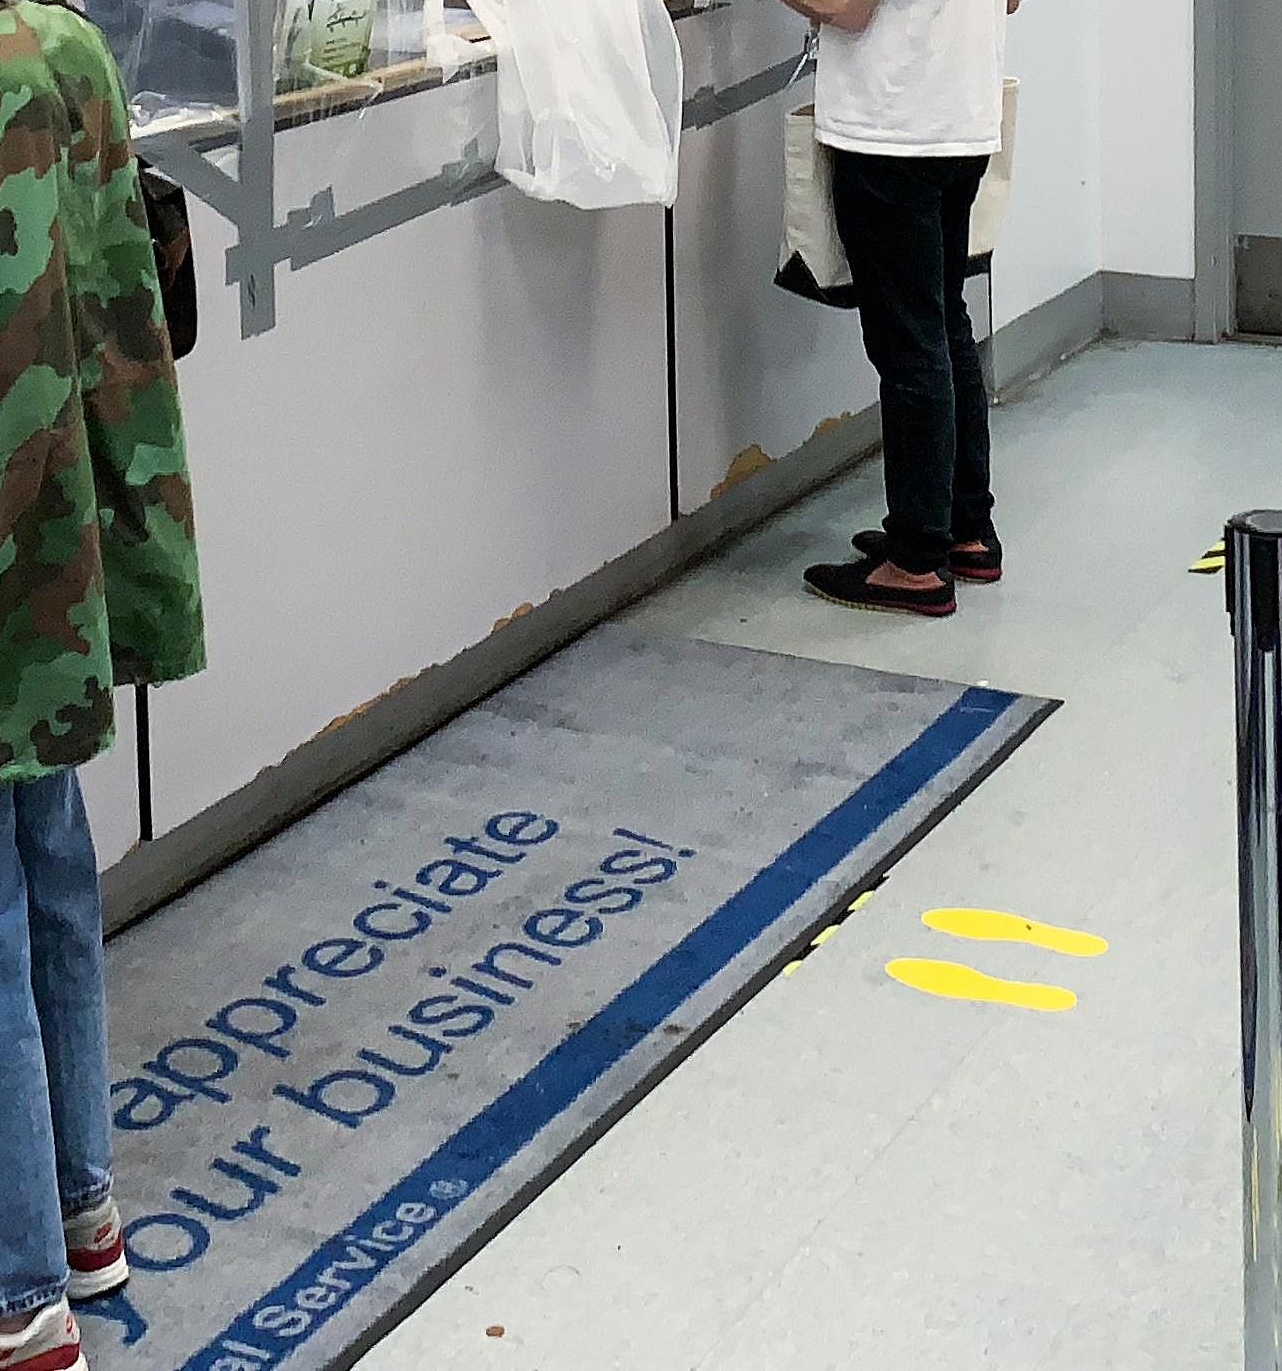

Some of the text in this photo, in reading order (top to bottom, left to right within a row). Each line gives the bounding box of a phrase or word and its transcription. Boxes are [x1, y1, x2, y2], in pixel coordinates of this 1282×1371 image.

[109, 809, 559, 1130] appreciate
[272, 827, 696, 1129] business!
[252, 1201, 439, 1338] Service
